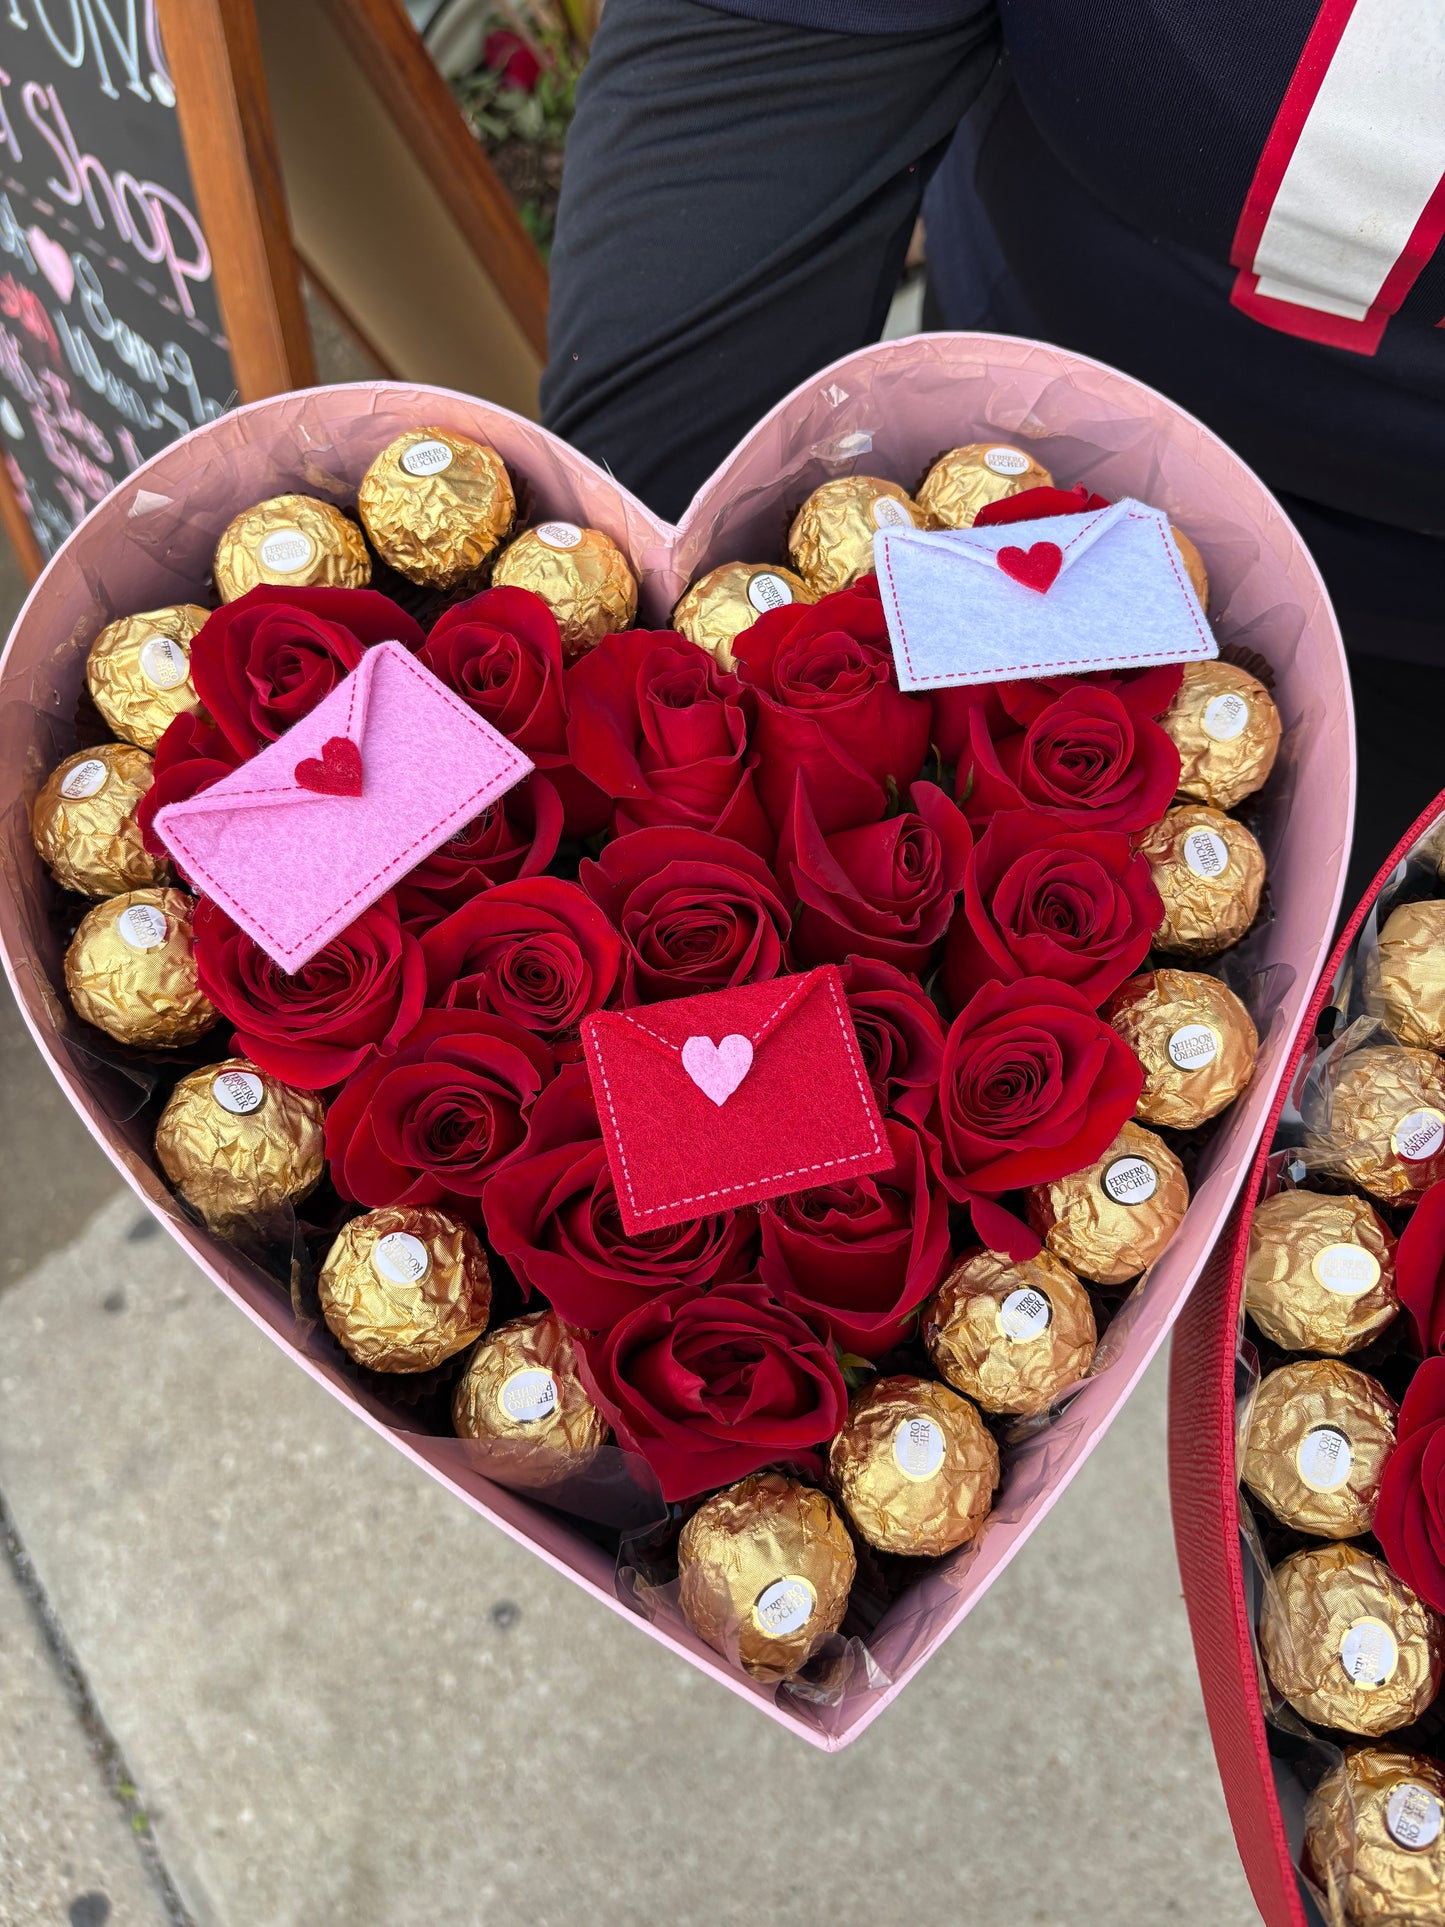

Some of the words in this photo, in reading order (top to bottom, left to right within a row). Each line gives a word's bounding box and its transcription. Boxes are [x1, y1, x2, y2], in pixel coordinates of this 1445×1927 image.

[405, 446, 447, 465] FERRERO
[408, 454, 450, 471] ROCHER
[987, 454, 1026, 464] FERRERO
[988, 459, 1026, 469] ROCHER
[264, 539, 306, 556] FERRERO
[266, 547, 308, 563] ROCHER
[755, 579, 774, 609] ROCHE
[65, 761, 95, 796] FERRERO
[1191, 836, 1212, 874] ROCHER
[1199, 832, 1221, 872] FERRERO
[1171, 1032, 1213, 1053] ROCHER
[1174, 1041, 1215, 1062] FERRERO
[219, 1075, 249, 1111] ROCHER
[228, 1072, 258, 1105] FERRERO
[1405, 1122, 1442, 1157] FERRERO
[1108, 1164, 1149, 1188] FERRERO
[1112, 1173, 1154, 1197] ROCHER
[506, 1390, 555, 1410] FERRERO
[760, 1584, 802, 1622] FERRERO
[765, 1592, 810, 1629] ROCHER
